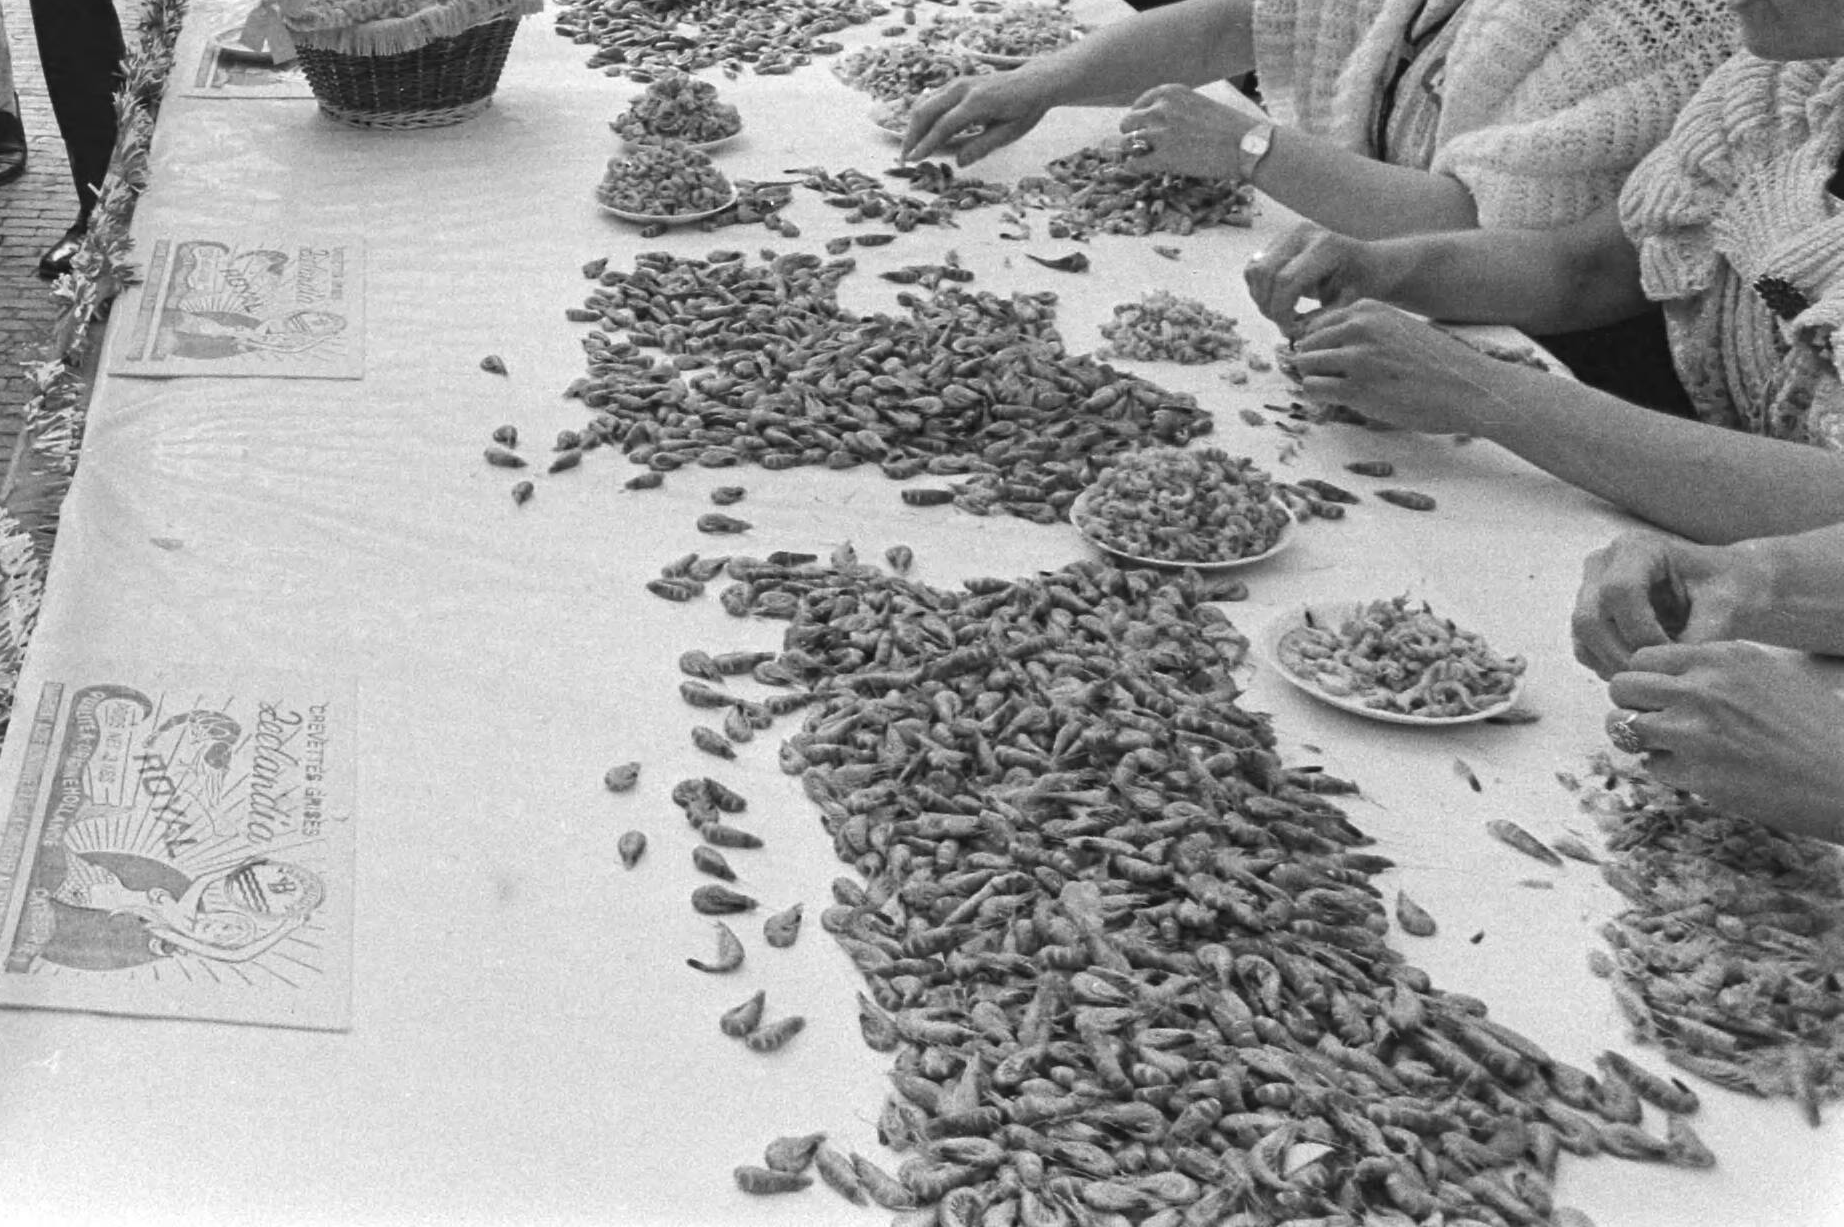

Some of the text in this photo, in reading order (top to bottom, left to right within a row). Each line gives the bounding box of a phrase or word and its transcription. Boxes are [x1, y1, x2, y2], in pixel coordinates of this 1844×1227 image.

[132, 753, 198, 859] ROYAL
[302, 704, 327, 837] CREVETTES GRISES
